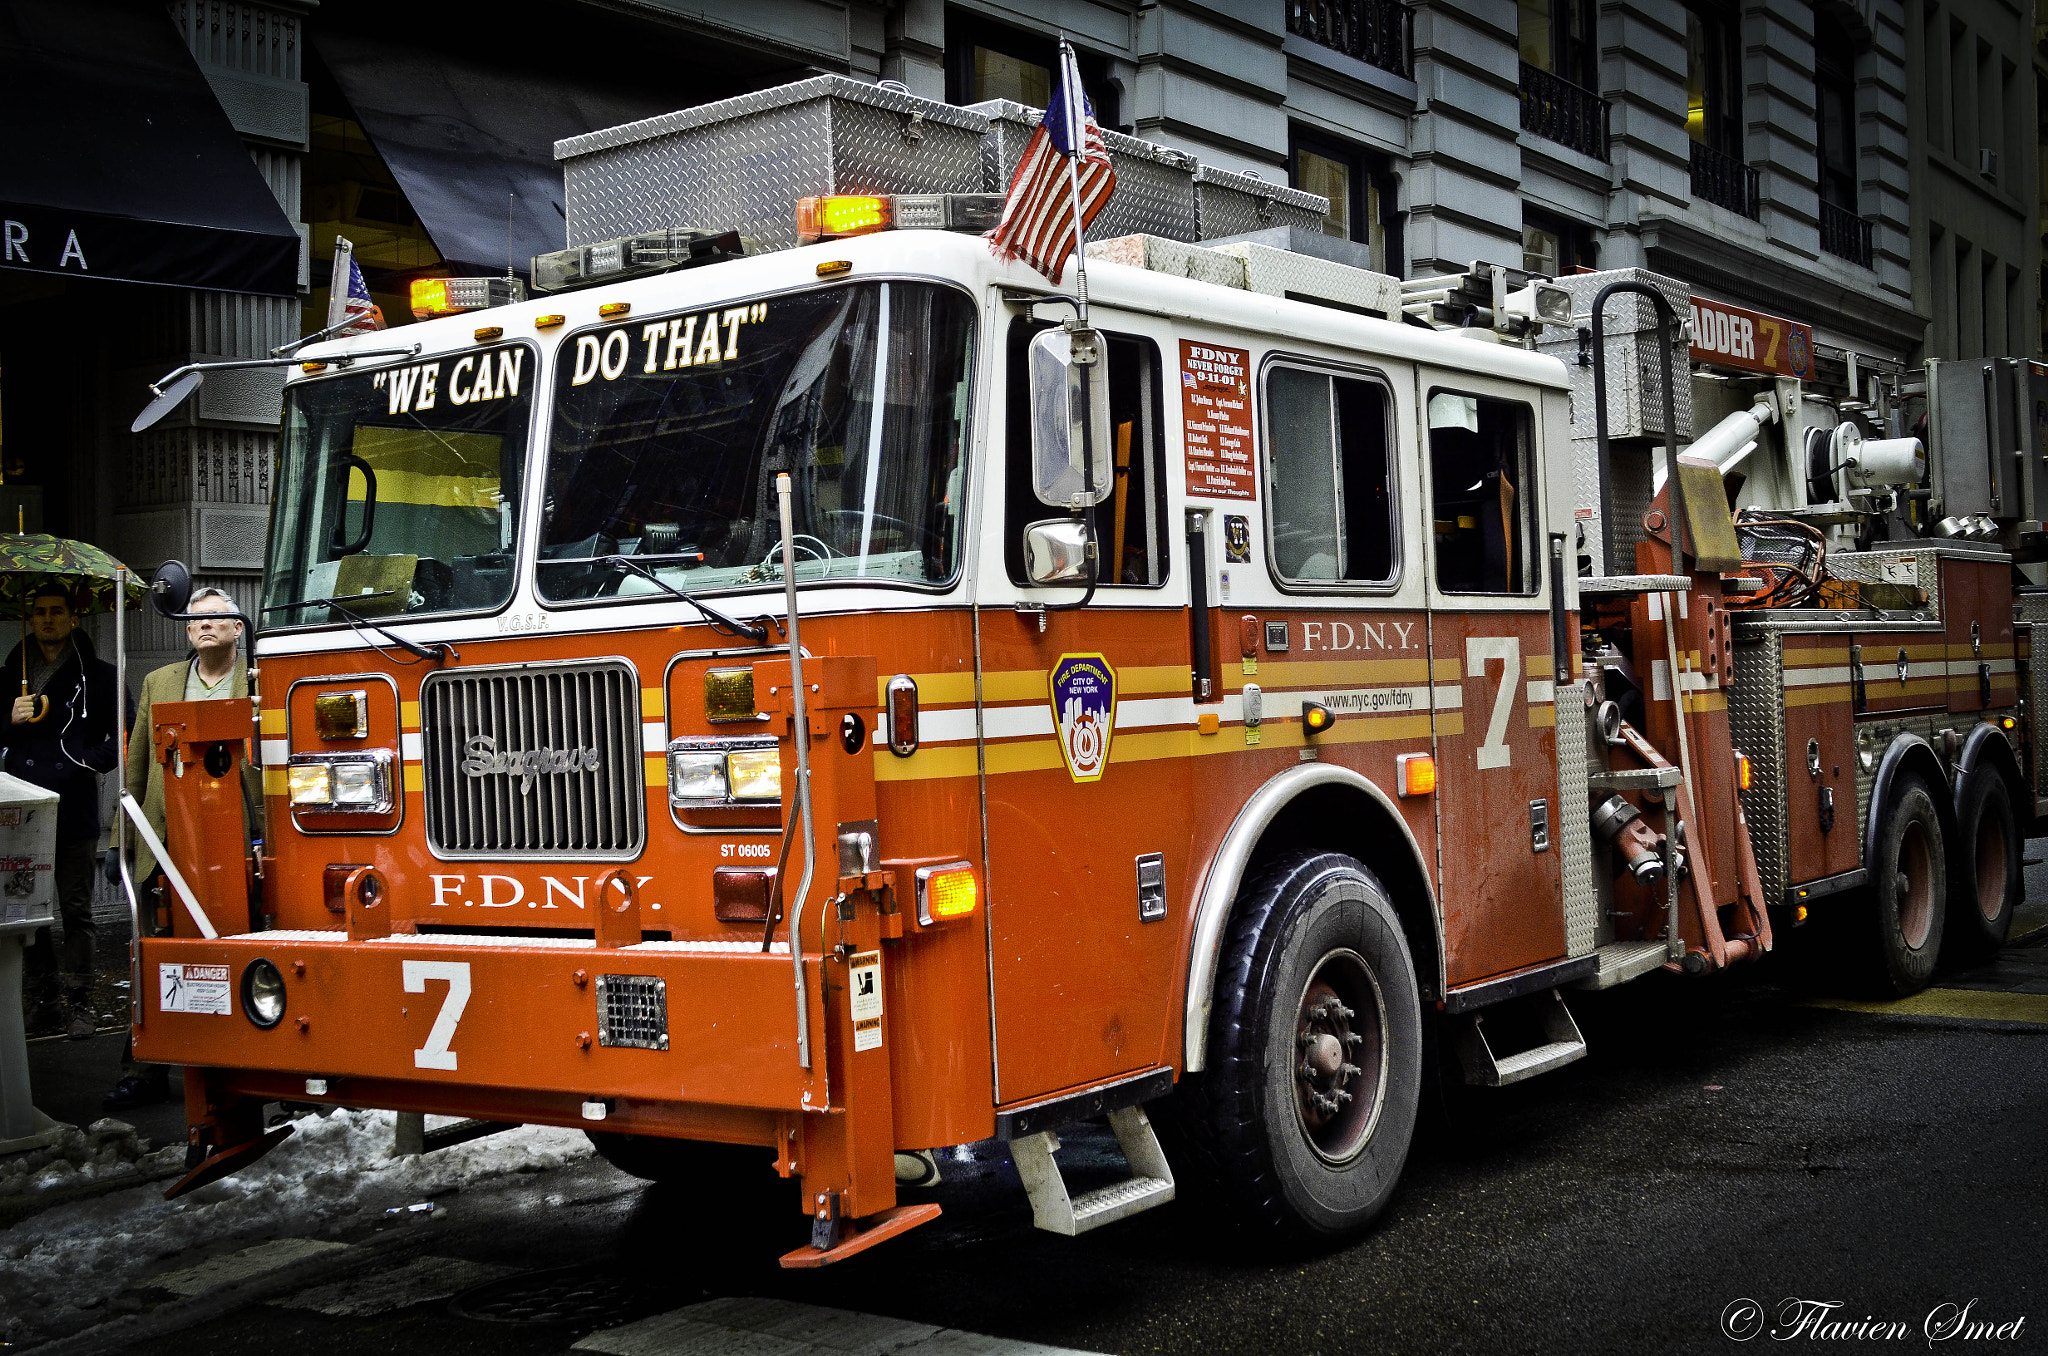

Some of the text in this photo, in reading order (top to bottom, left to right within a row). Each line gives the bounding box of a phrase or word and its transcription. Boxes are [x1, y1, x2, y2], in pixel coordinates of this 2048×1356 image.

[1759, 318, 1781, 369] 7
[373, 302, 768, 415] "WE CAN DO THAT"
[1190, 346, 1240, 365] FDNY
[1187, 358, 1244, 377] NEVER FORGET
[1196, 371, 1236, 386] 9-11-01
[1192, 485, 1212, 493] Forever
[1227, 488, 1250, 497] Thoughts
[497, 613, 550, 632] V.G.S.F.
[1301, 622, 1420, 651] F.D.N.Y.
[1057, 663, 1109, 687] FIRE DEPARTMENT
[1323, 688, 1413, 711] www.nyc.gov/fdny
[1465, 636, 1521, 770] 7
[461, 734, 600, 796] Seagrave
[720, 843, 771, 858] ST 06005
[428, 874, 662, 910] F.D.N.
[854, 955, 879, 967] WARNING
[194, 967, 227, 980] DANGER
[402, 959, 472, 1071] 7
[859, 1017, 880, 1029] WARNING
